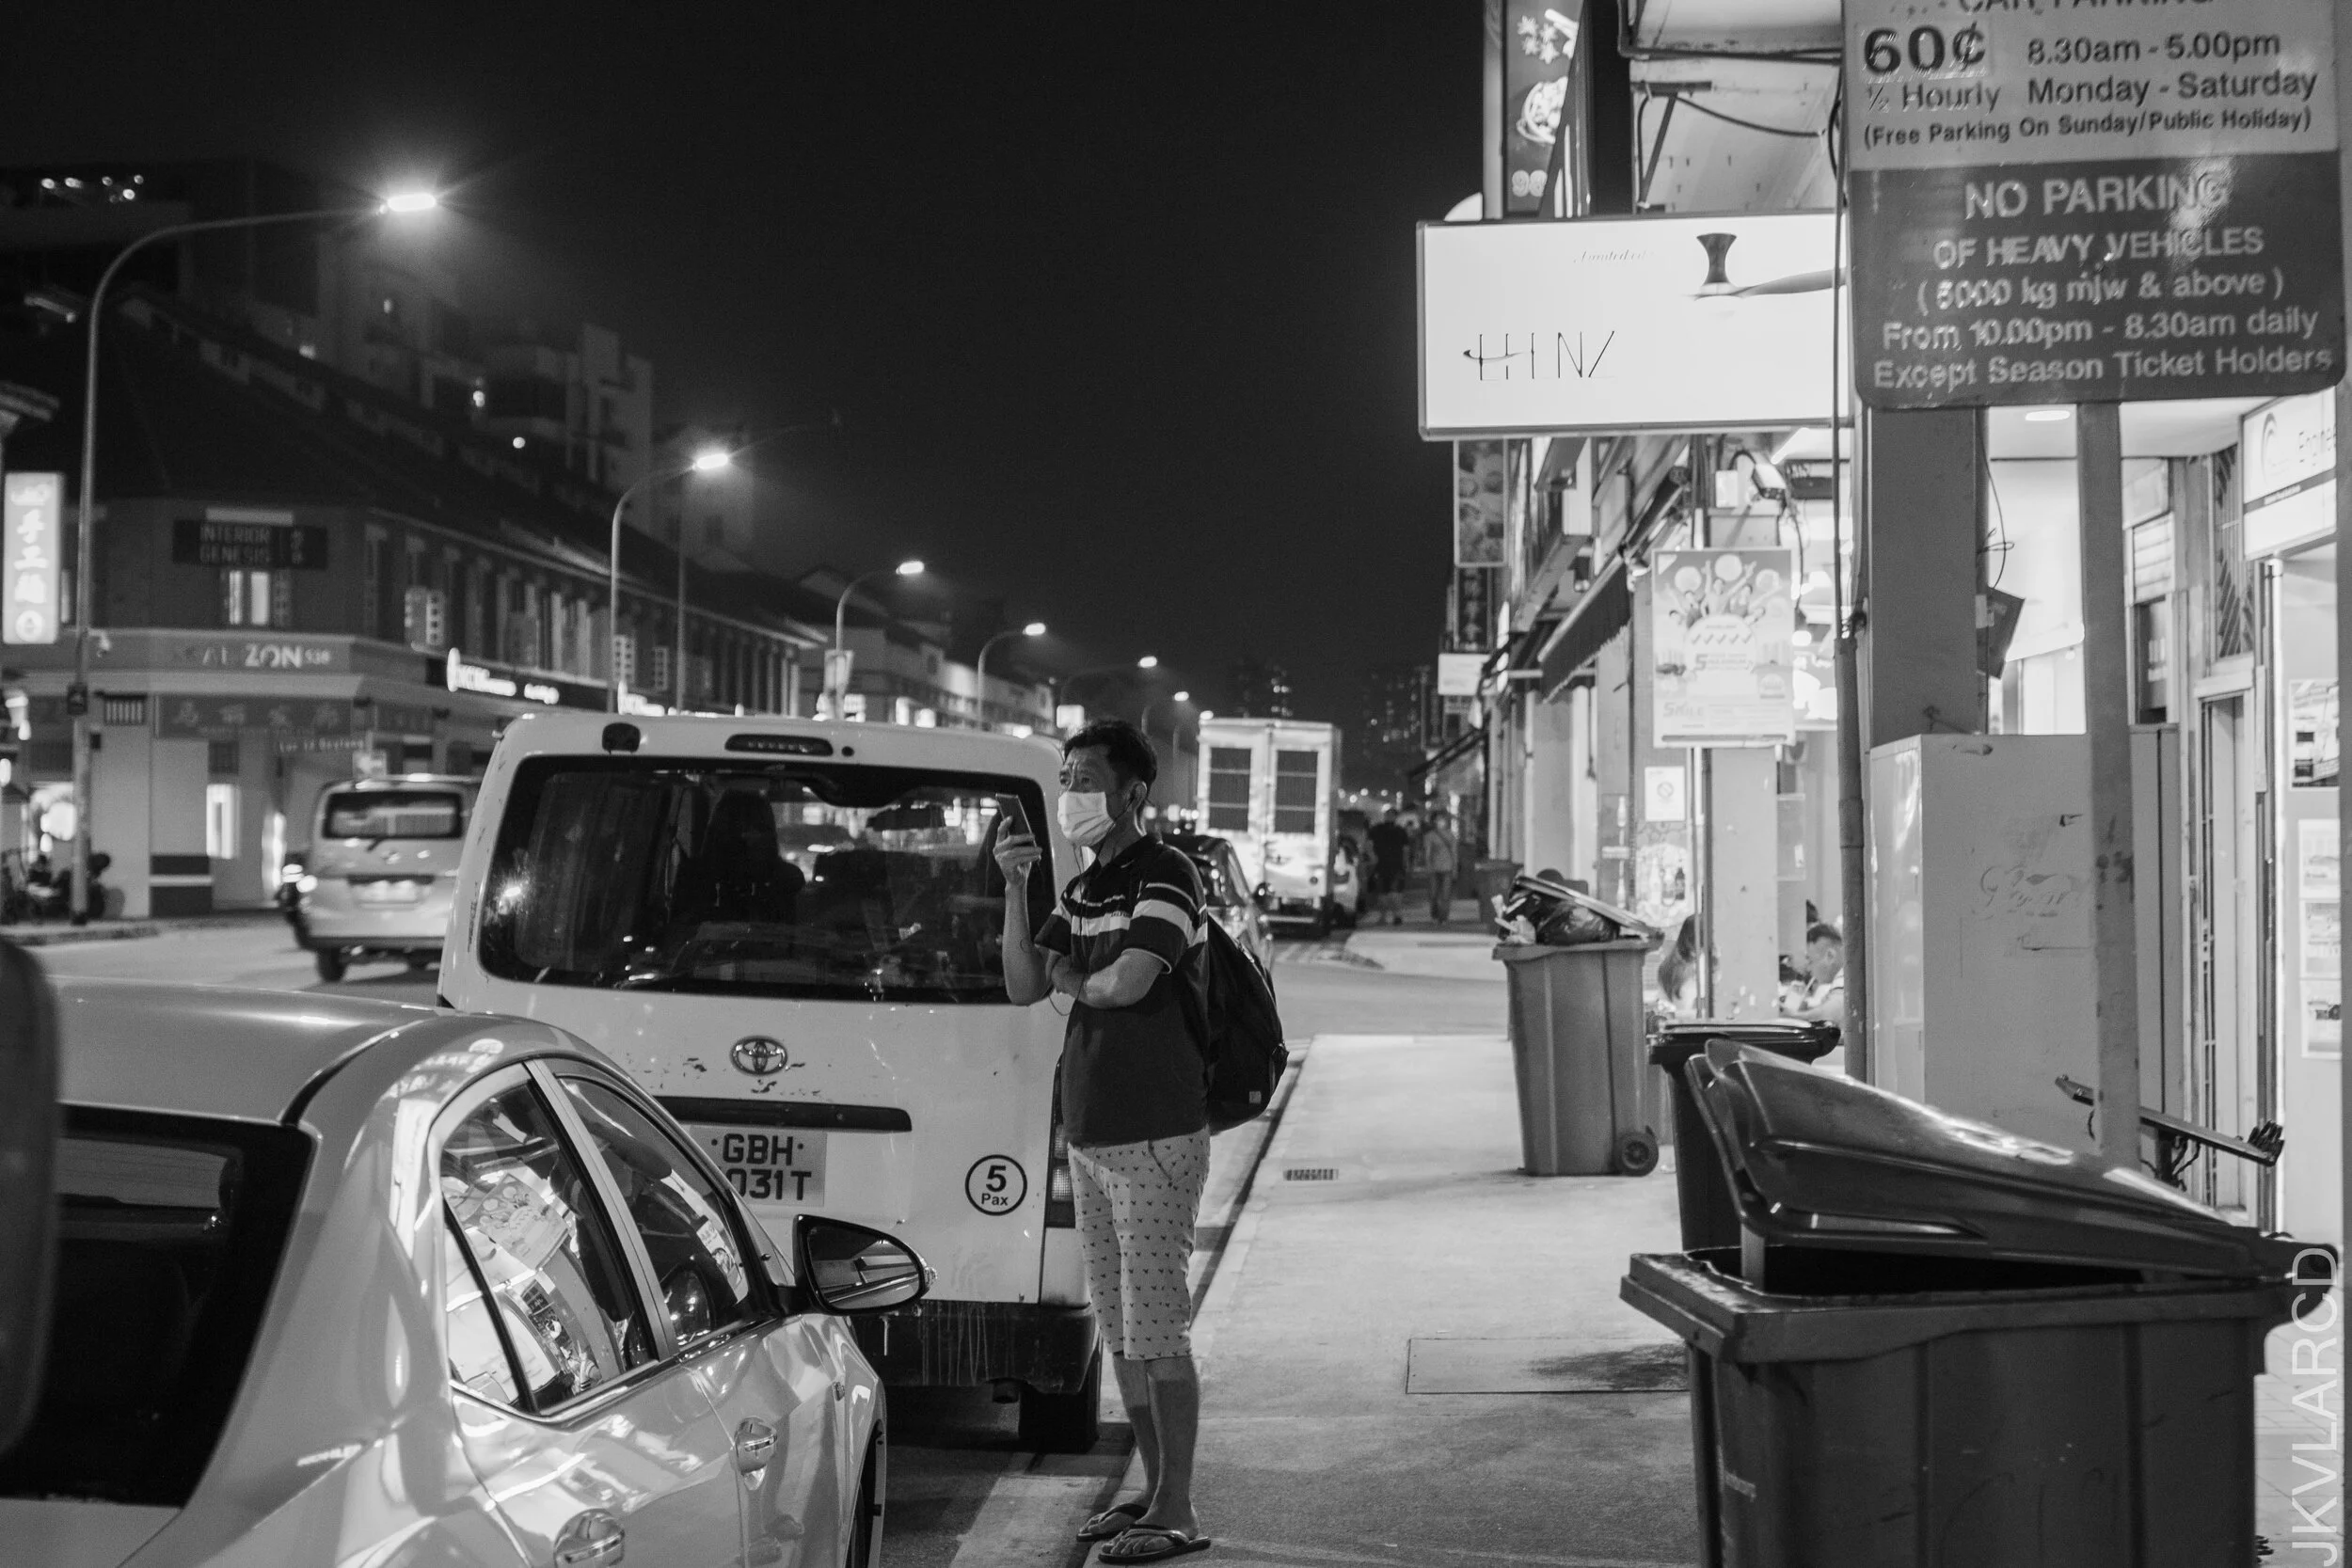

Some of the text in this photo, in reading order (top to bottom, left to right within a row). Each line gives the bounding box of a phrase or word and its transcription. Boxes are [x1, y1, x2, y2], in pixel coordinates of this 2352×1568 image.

[2026, 36, 2140, 66] 8.30am
[2166, 31, 2281, 66] 5.00pm
[1901, 81, 2001, 113] Hourly
[2026, 74, 2151, 108] Monday
[2177, 69, 2318, 103] Saturday
[1863, 104, 2312, 150] (Free Parking On Sunday/Public Holiday)
[1963, 171, 2229, 220] NO PARKING
[1932, 227, 2265, 270] OF HEAVY VEHICLES
[2020, 276, 2058, 309] kg
[2137, 270, 2163, 299] &
[2172, 270, 2267, 297] above
[1883, 321, 1960, 351] From
[1968, 316, 2093, 350] 10.00pm
[2123, 313, 2237, 341] 8.30am
[2246, 307, 2319, 340] daily
[1873, 346, 2333, 393] Except Season Ticket Holders
[722, 1132, 795, 1166] GBH
[720, 1166, 813, 1201] 031T
[986, 1165, 1008, 1193] 5
[980, 1192, 1009, 1208] Pax
